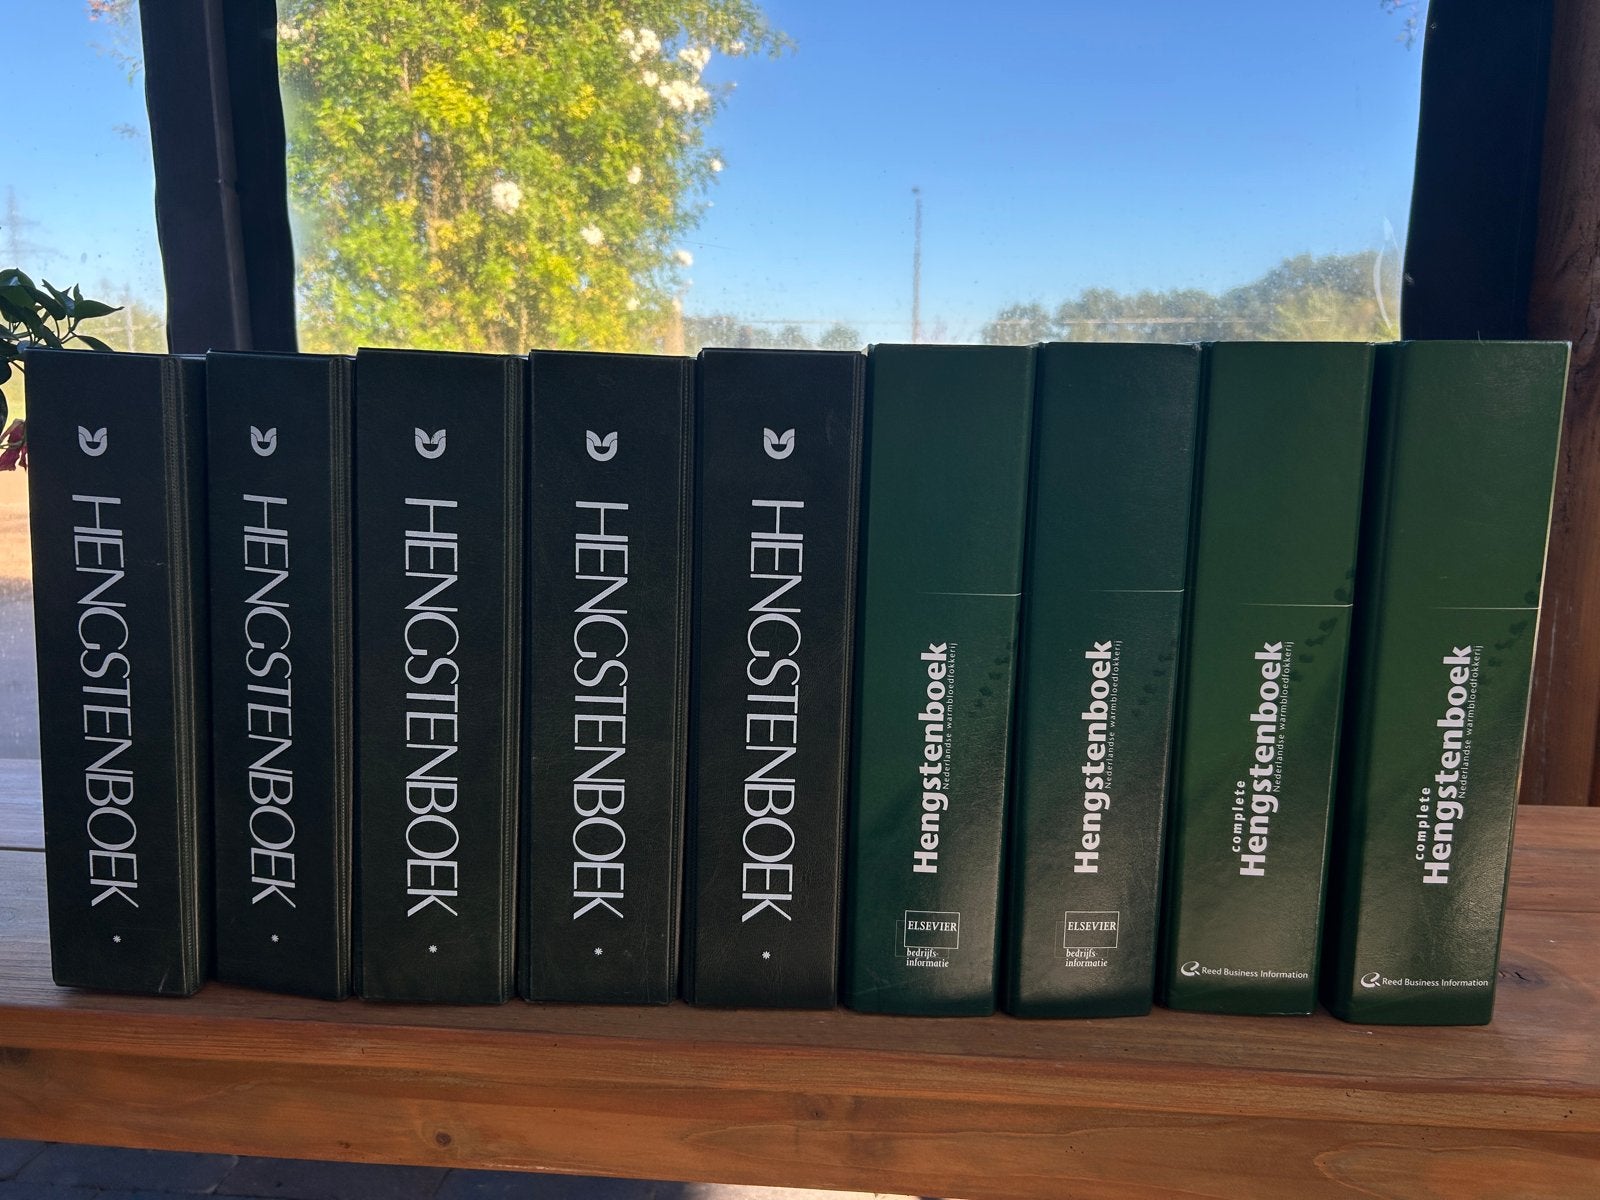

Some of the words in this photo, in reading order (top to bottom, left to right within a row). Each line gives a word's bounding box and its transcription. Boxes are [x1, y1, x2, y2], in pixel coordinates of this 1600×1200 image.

[72, 495, 139, 909] HENGSTENBOEK
[243, 494, 296, 908] HENGSTENBOEK
[404, 499, 458, 918] HENGSTENBOEK
[572, 501, 630, 920] HENGSTENBOEK
[741, 500, 804, 923] HENGSTENBOEK
[913, 642, 948, 873] Hengstenboek
[946, 643, 959, 728] warmbloedfokkerij
[1074, 640, 1112, 873] Hengstenboek
[1105, 732, 1115, 789] Nederlandse
[1110, 640, 1122, 727] warmbloedfokkerij
[1240, 641, 1283, 876] Hengstenboek
[1273, 734, 1285, 792] Nederlandse
[1279, 641, 1294, 730] warmbloedfokkerij
[1458, 740, 1471, 798] Nederlandse
[1466, 645, 1483, 735] warmbloedfokkerij
[943, 733, 952, 790] Nederlandse
[1232, 780, 1245, 852] complete
[1415, 787, 1430, 860] complete
[1423, 645, 1472, 884] Hengstenboek
[907, 958, 949, 968] informatie
[908, 921, 957, 932] ELSEVIER
[1066, 958, 1108, 967] informatie
[1068, 921, 1117, 932] ELSEVIER
[1202, 966, 1222, 975] Reed
[1224, 967, 1258, 977] Business
[1261, 969, 1308, 978] Information
[1382, 978, 1403, 986] Reed
[1405, 978, 1439, 987] Business
[1442, 979, 1488, 987] Information
